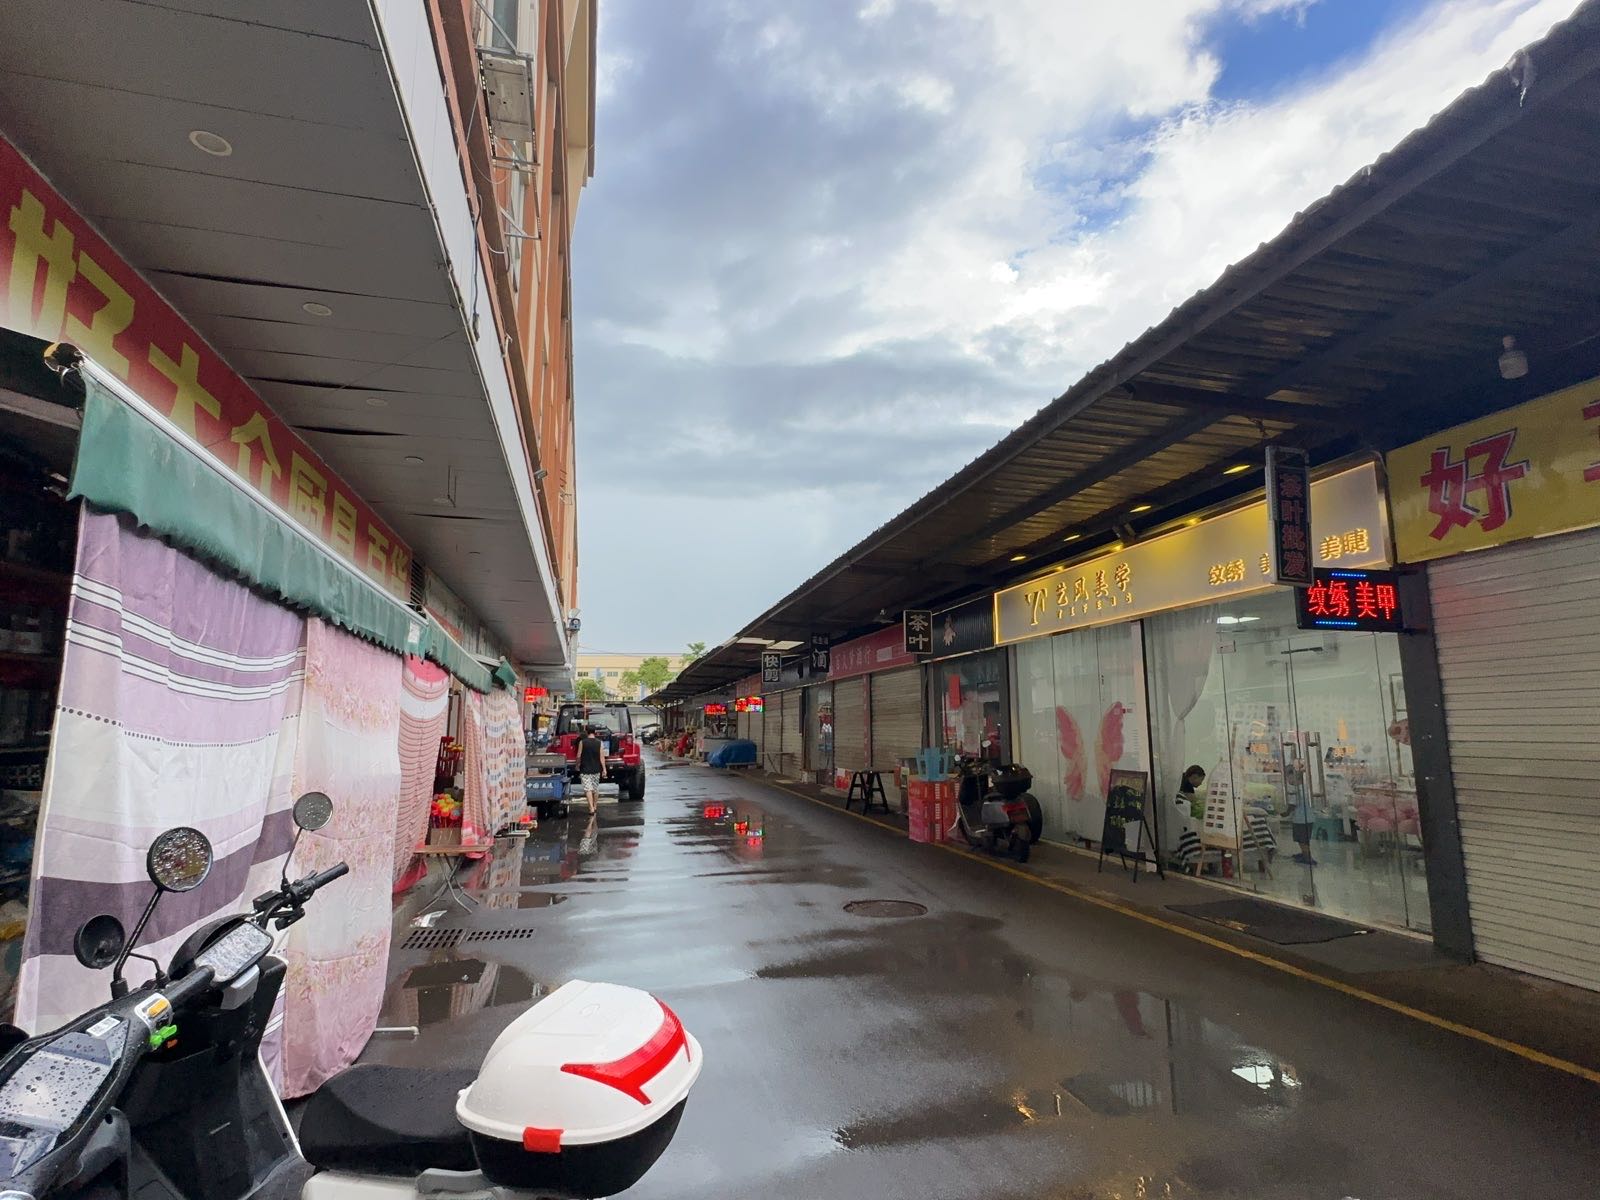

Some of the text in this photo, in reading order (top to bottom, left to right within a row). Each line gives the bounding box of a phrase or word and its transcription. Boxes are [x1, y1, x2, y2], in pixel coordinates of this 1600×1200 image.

[1280, 474, 1307, 578] 茶叶批发
[1209, 559, 1245, 586] 纹绣
[1308, 580, 1396, 620] 纹绣 美甲
[908, 614, 929, 650] 茶叶
[764, 655, 780, 682] 快剪
[812, 648, 828, 669] 酒
